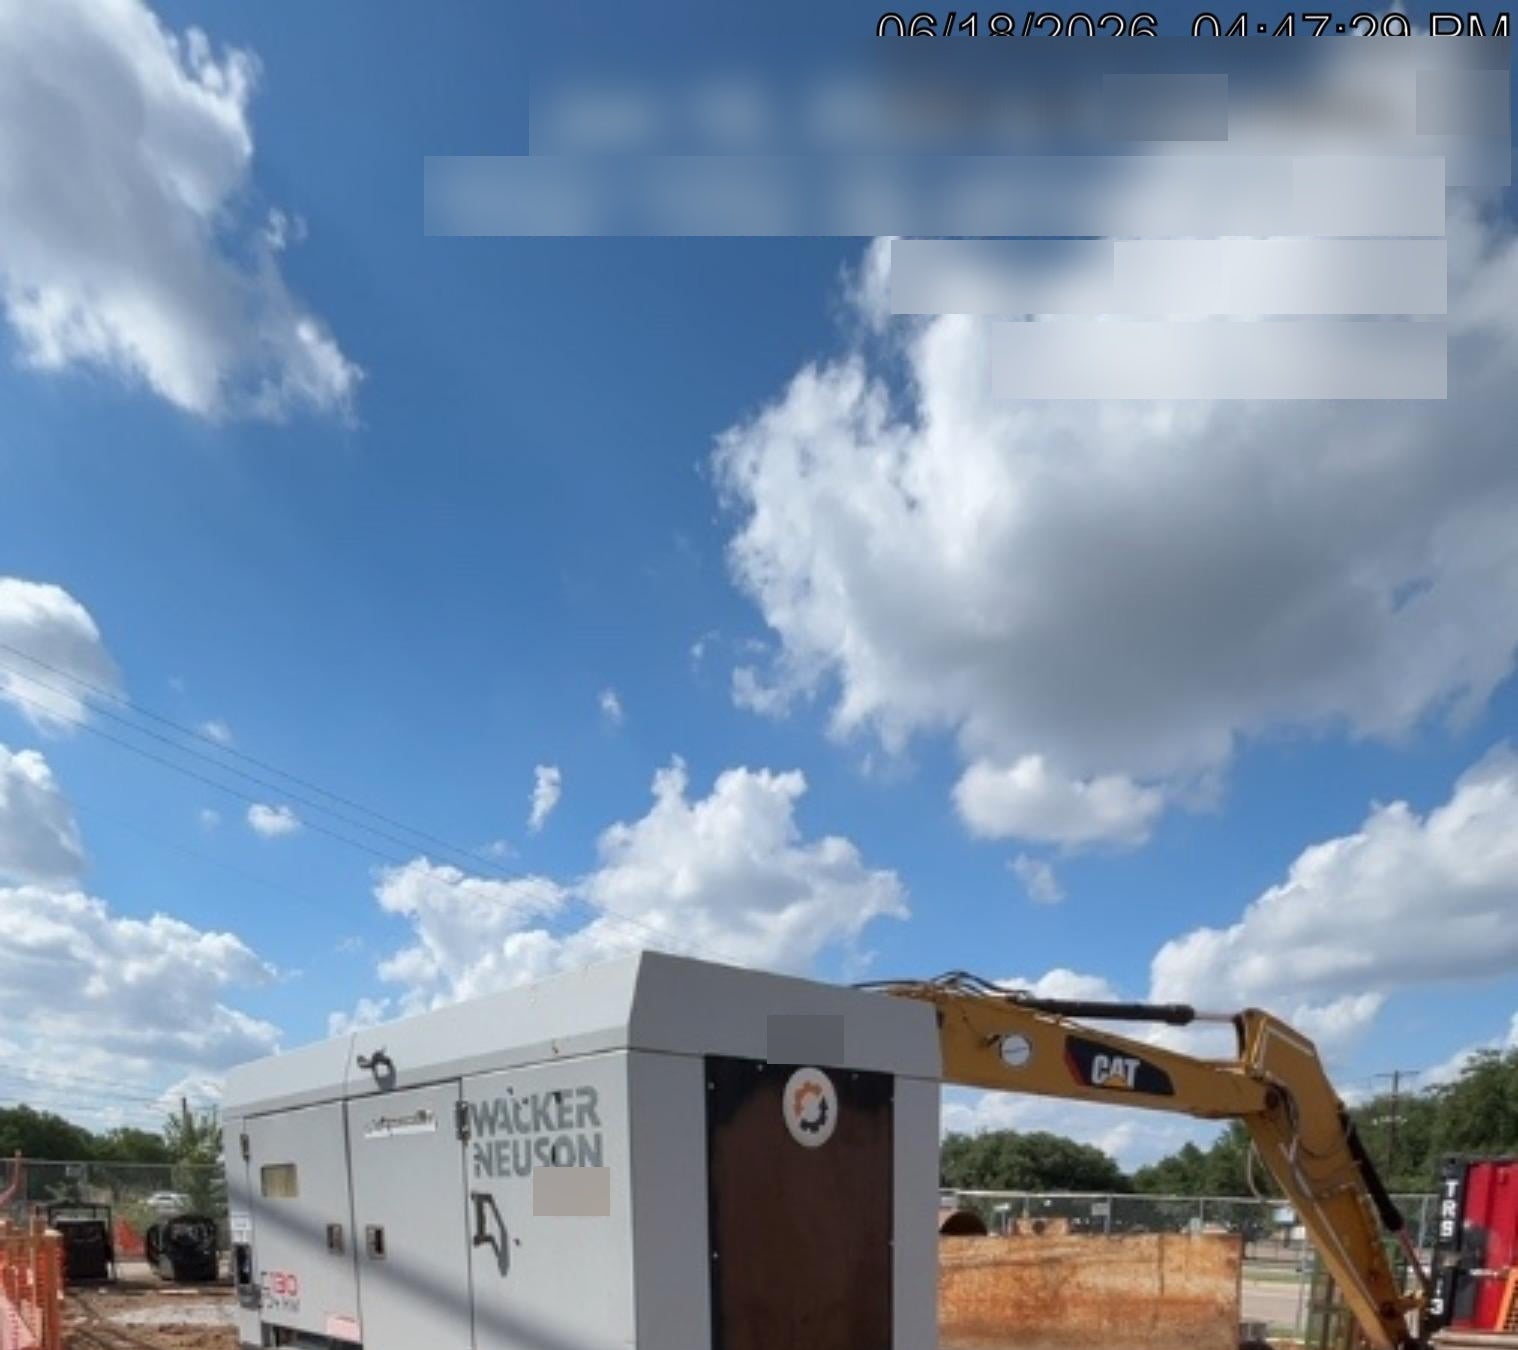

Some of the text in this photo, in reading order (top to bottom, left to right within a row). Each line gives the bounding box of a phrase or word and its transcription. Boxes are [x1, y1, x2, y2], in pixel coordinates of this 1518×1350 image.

[1091, 1054, 1141, 1090] CAT
[470, 1085, 602, 1137] WACKER
[473, 1133, 603, 1178] NEUSON
